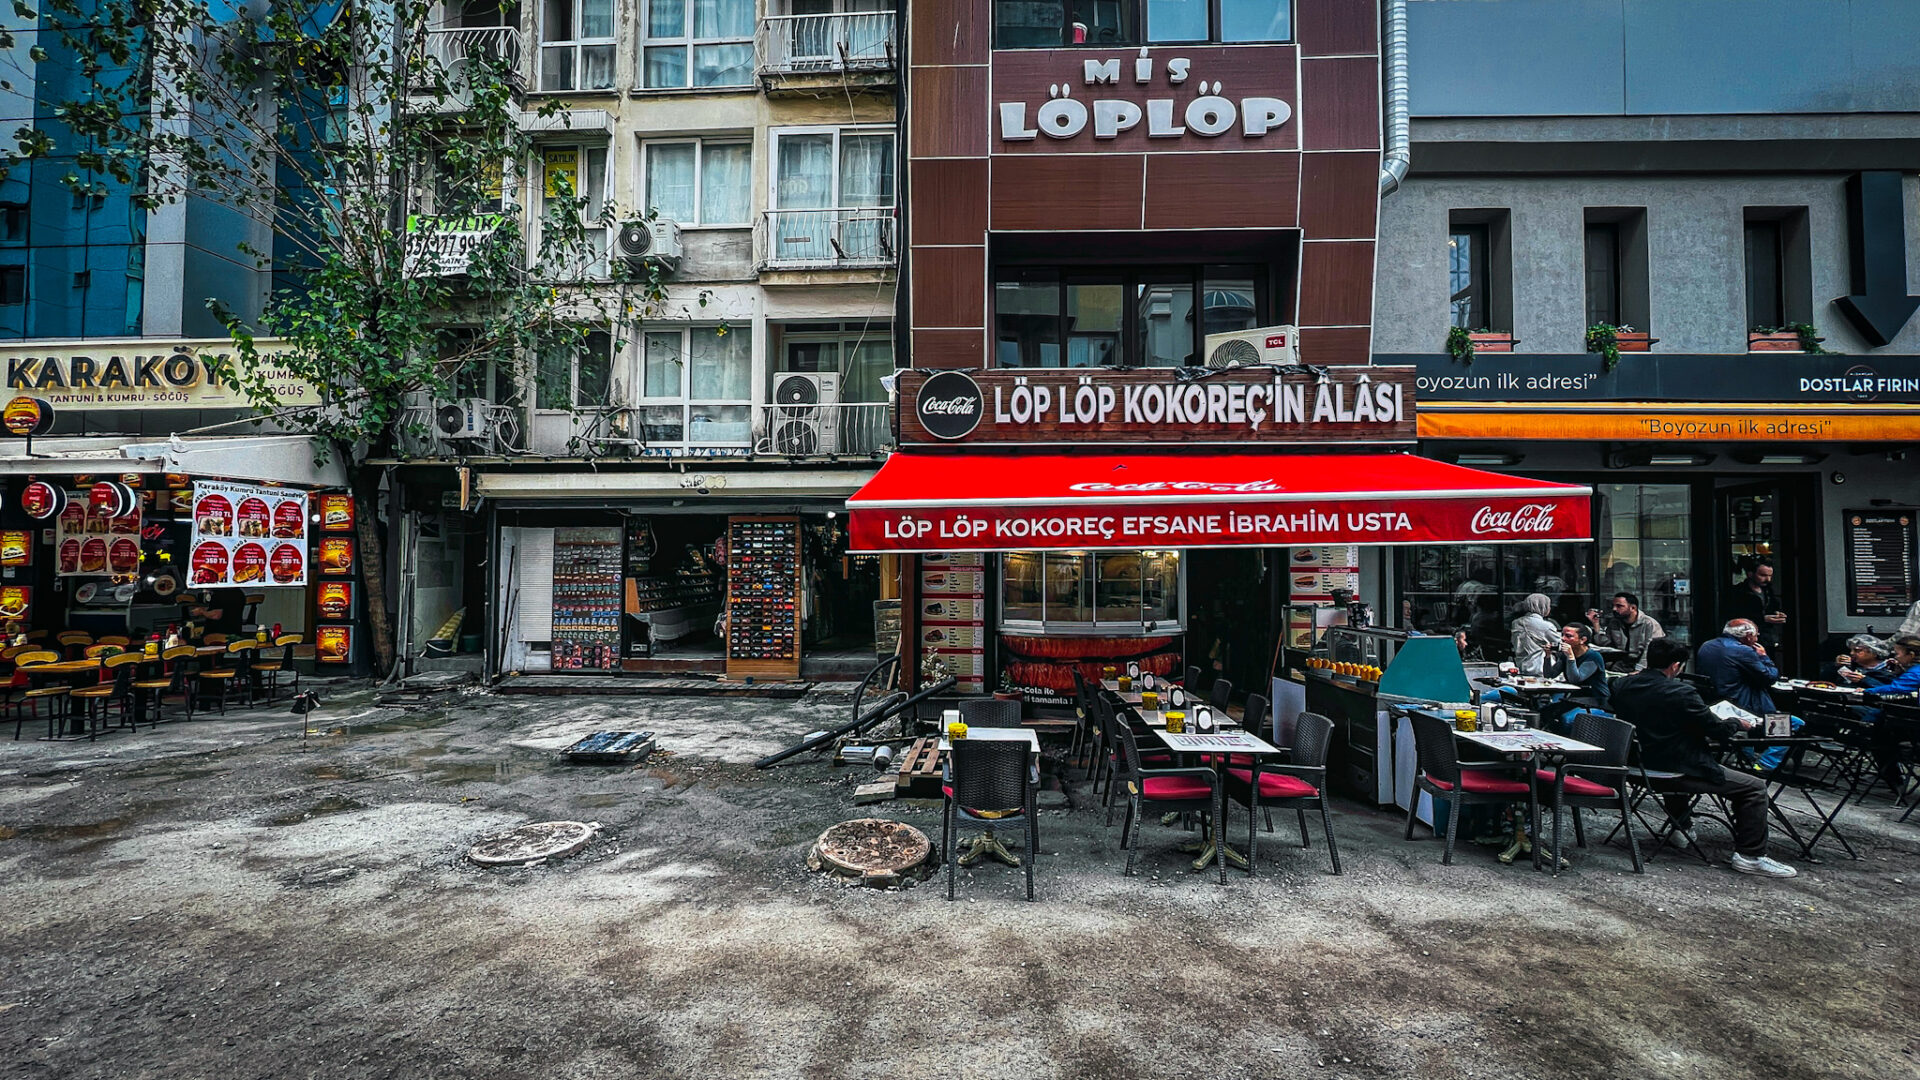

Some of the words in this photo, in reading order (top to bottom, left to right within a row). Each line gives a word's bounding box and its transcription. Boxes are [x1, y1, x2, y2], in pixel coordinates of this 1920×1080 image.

[1084, 46, 1191, 85] MİS
[999, 81, 1292, 141] LÖPLÖP
[548, 152, 576, 164] SATILIK
[7, 345, 231, 388] KARAKÖY
[1498, 372, 1519, 390] ilk
[1800, 378, 1874, 392] DOSTLAR
[1877, 378, 1919, 392] FIRIN
[49, 393, 94, 403] TANTUNİ
[97, 394, 104, 402] &
[107, 394, 145, 402] KUMRU
[922, 396, 978, 415] Coca-Cola
[995, 376, 1051, 423] LÖP
[1059, 376, 1115, 423] LÖP
[1739, 418, 1758, 434] ilk
[198, 482, 228, 492] Karaköy
[230, 485, 253, 494] Kumru
[256, 488, 279, 496] Tantuni
[884, 515, 932, 539] LÖP
[940, 514, 988, 538] LÖP
[995, 516, 1115, 540] KOKOREÇ
[1122, 515, 1222, 535] EFSANE
[1229, 509, 1340, 533] İBRAHİM
[1347, 512, 1413, 532] USTA
